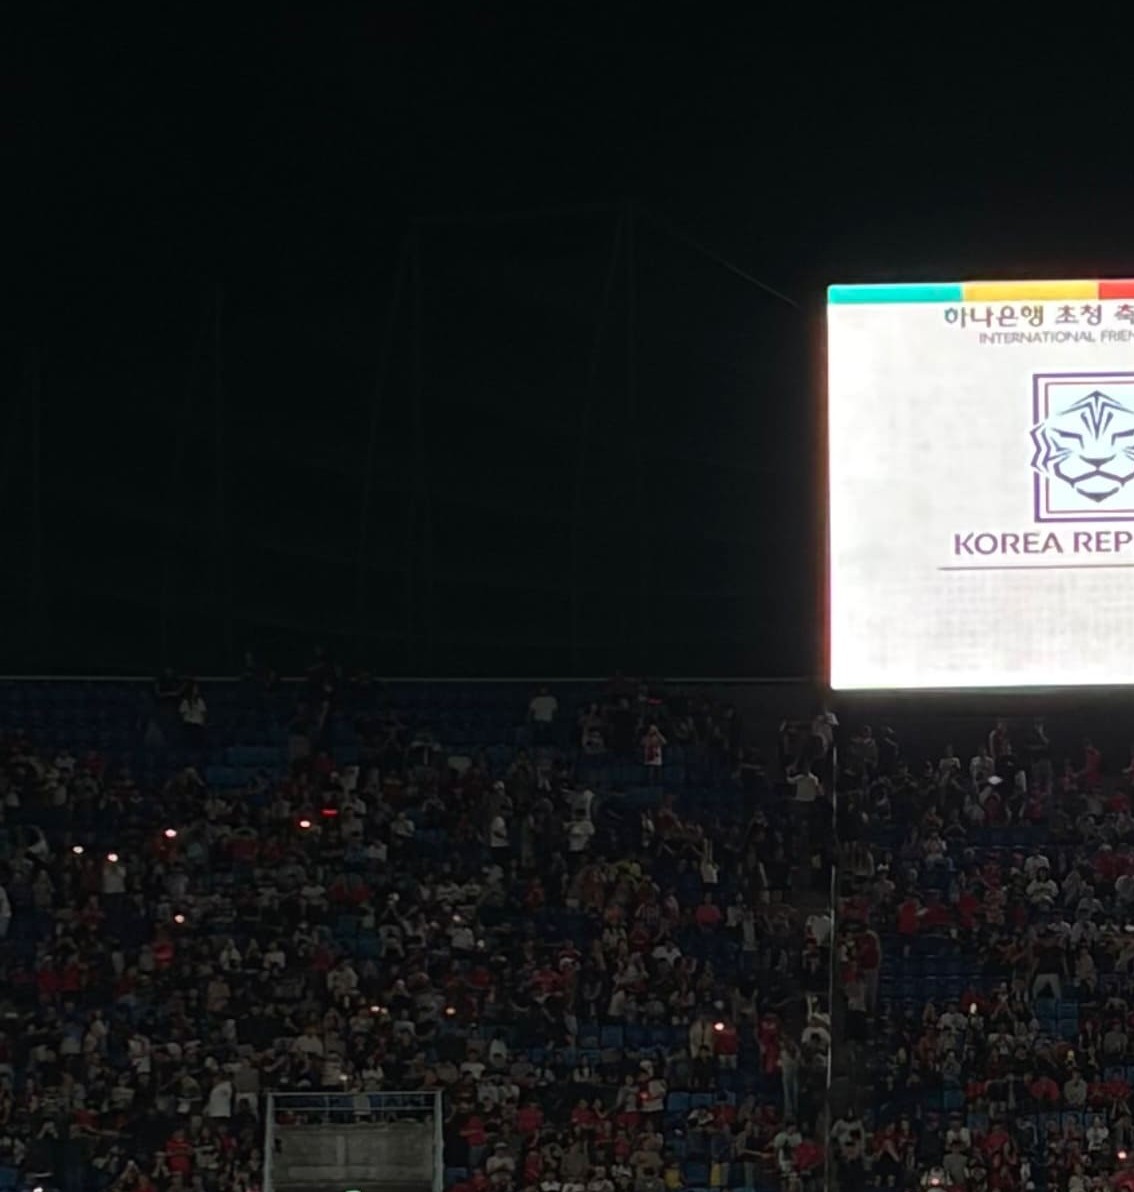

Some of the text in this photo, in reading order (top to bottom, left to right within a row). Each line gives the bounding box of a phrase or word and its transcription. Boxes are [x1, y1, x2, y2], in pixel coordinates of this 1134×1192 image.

[944, 305, 1045, 328] 하나은행
[1055, 304, 1103, 325] 초청
[979, 331, 1096, 345] INTERNATIONAL
[954, 532, 1063, 555] KOREA
